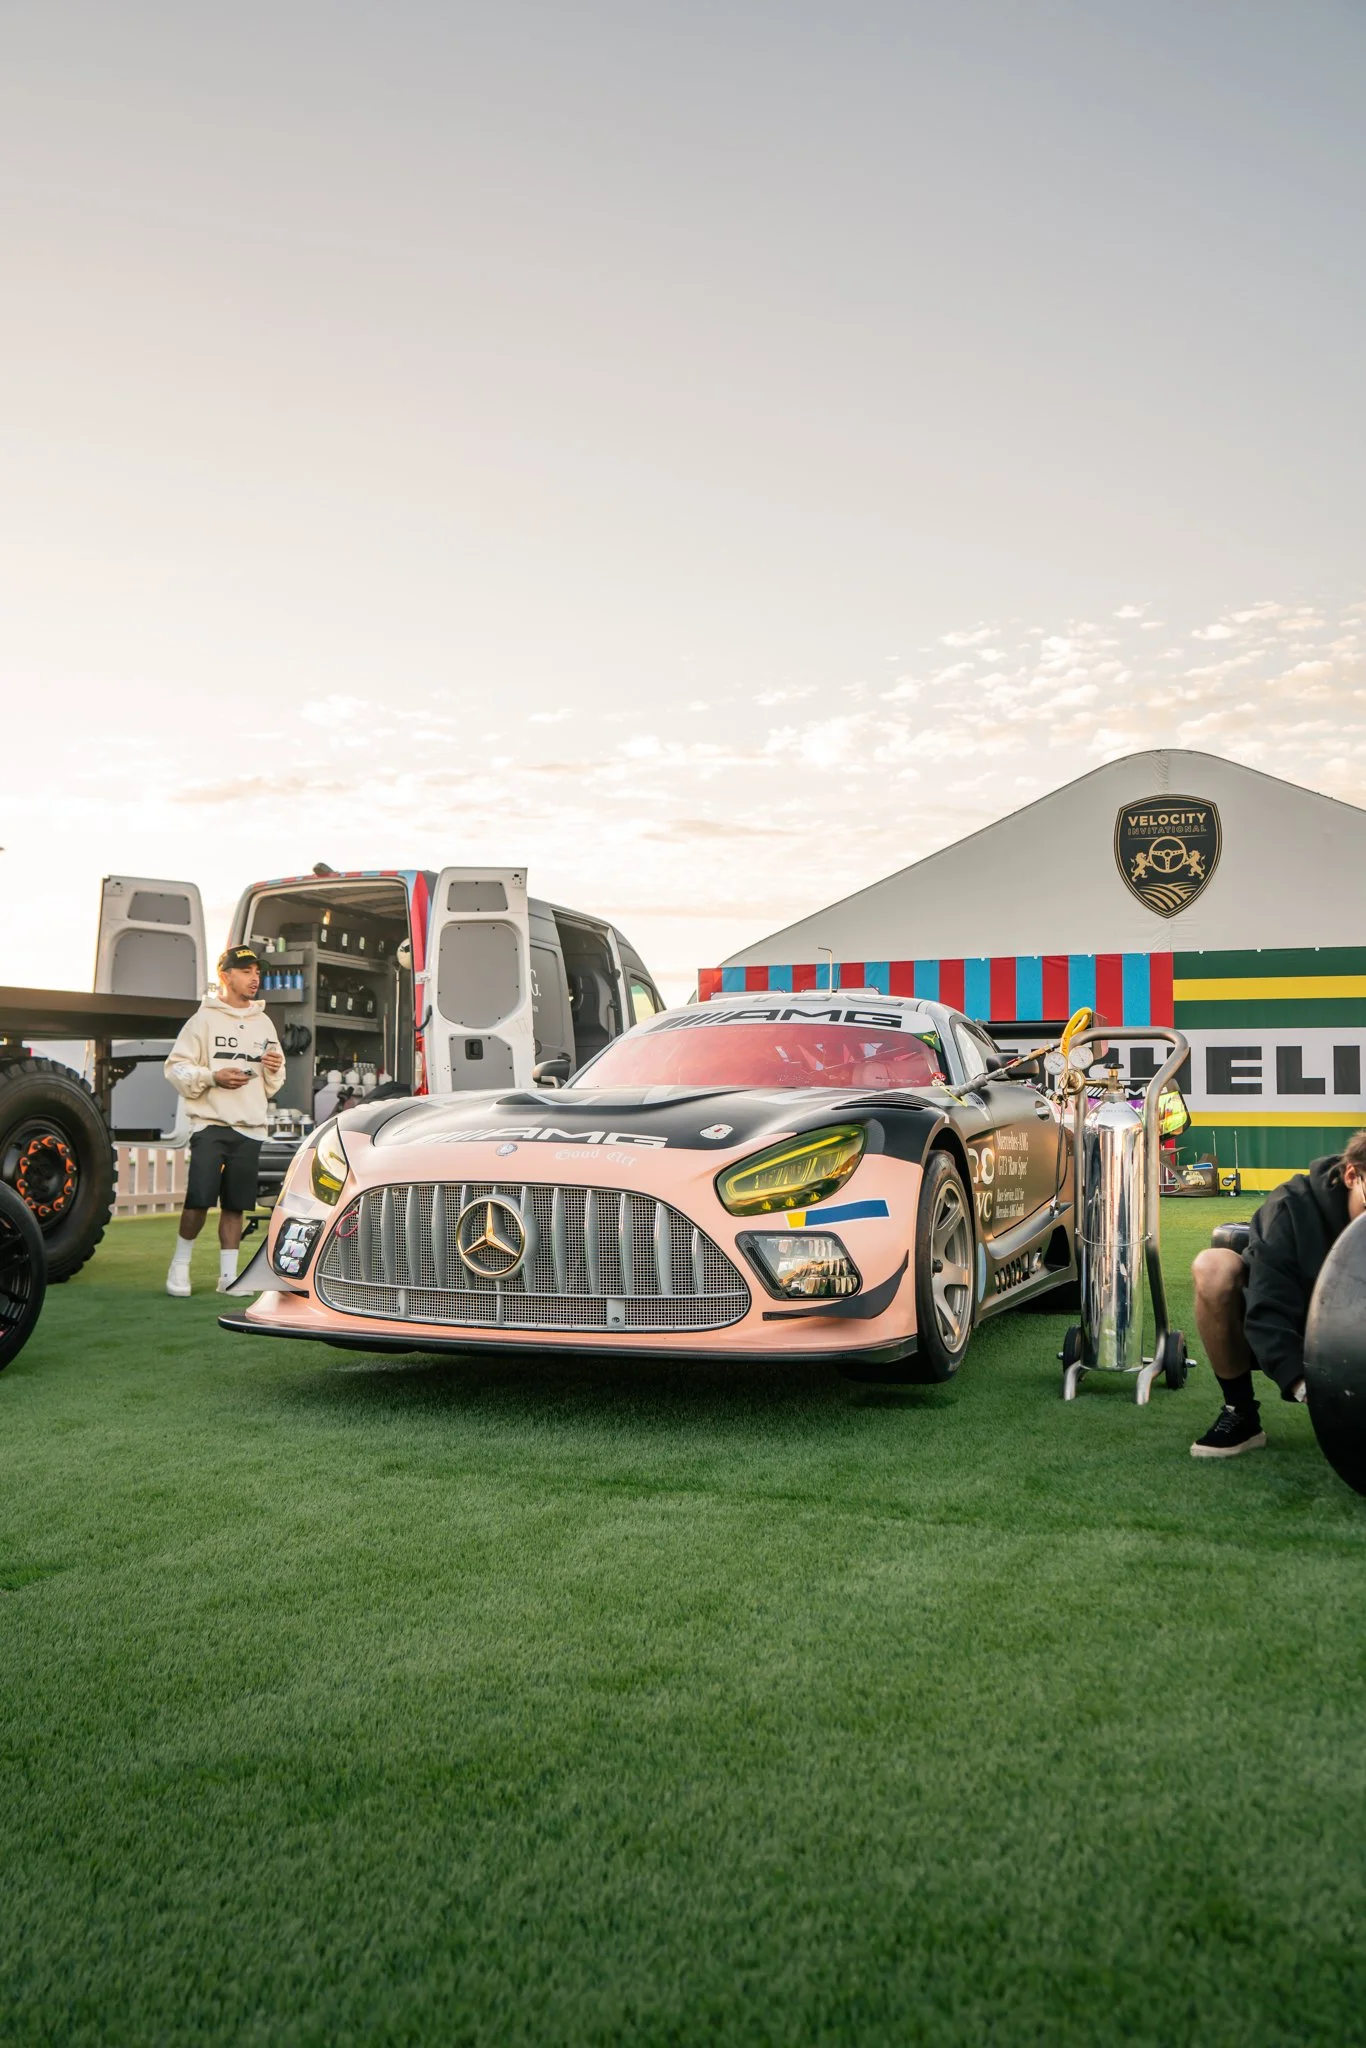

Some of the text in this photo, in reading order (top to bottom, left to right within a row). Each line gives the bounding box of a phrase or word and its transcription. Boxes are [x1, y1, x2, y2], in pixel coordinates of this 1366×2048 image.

[1128, 813, 1206, 827] VELOCITY
[1127, 825, 1207, 836] INVITATIONAL
[713, 1008, 903, 1029] AMG
[472, 1127, 669, 1149] AMG
[555, 1148, 601, 1161] Good
